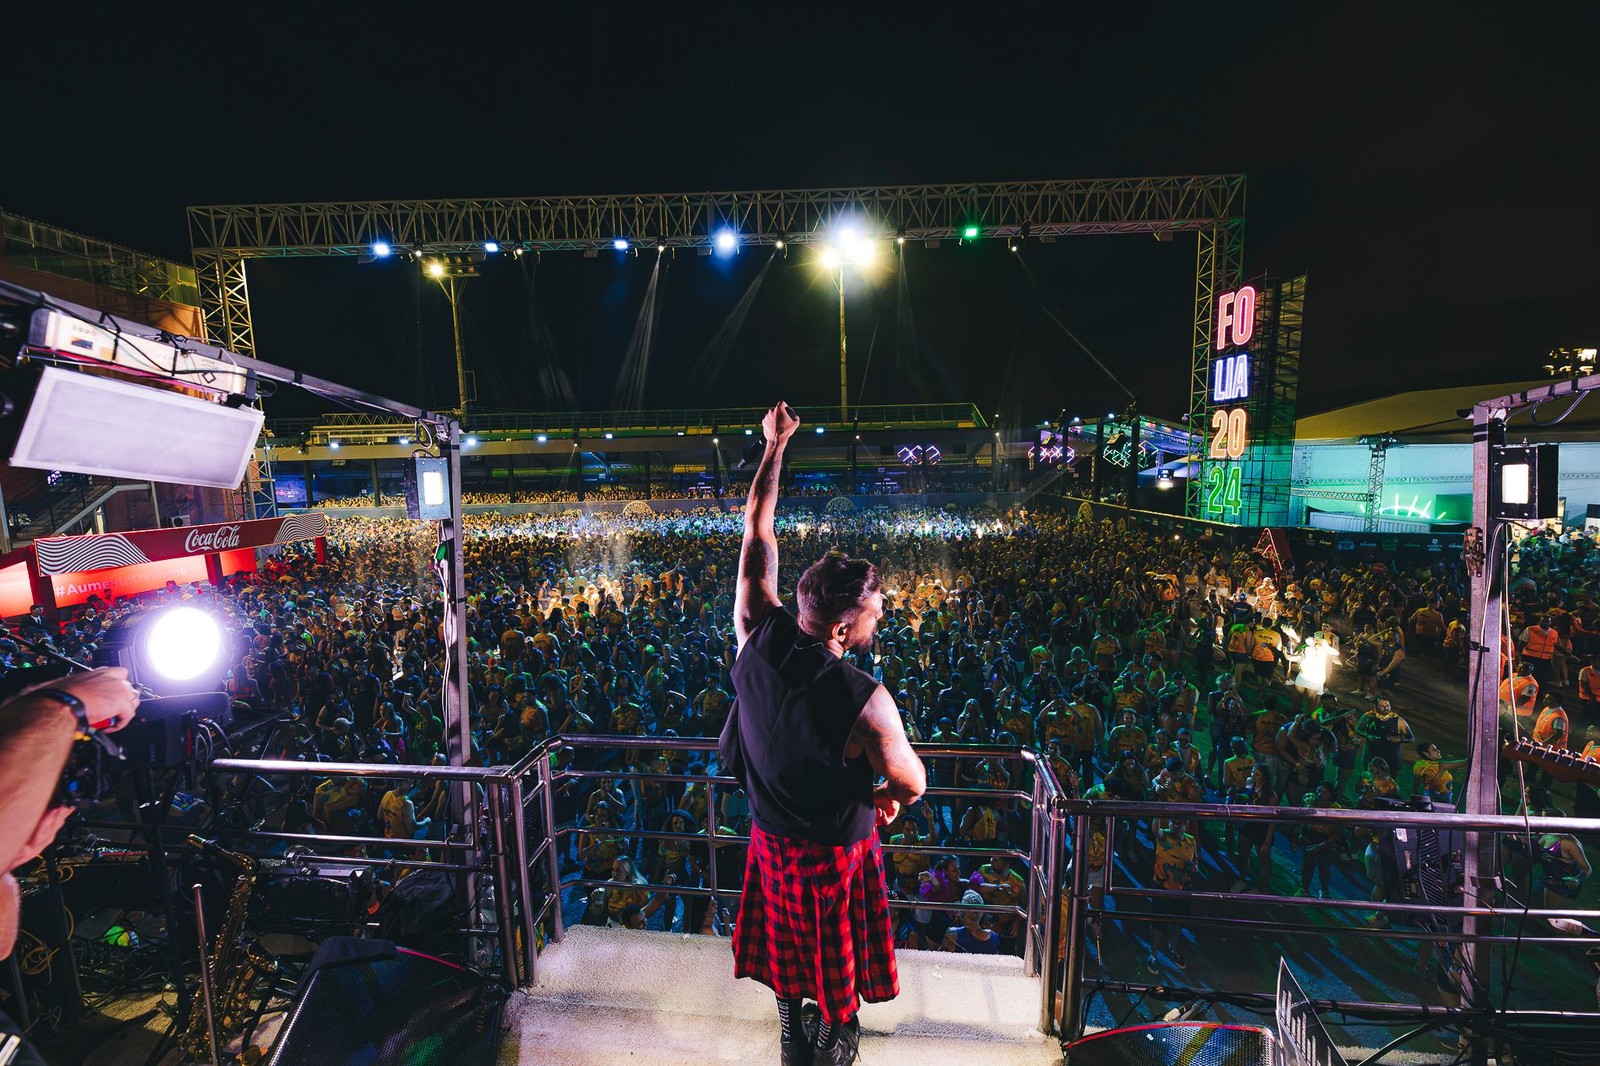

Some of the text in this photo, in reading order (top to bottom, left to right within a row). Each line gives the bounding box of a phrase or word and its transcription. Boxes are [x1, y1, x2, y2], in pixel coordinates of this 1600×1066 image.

[1216, 286, 1256, 351] FO
[1213, 353, 1249, 401] LIA
[1210, 408, 1247, 460] 20
[1207, 466, 1242, 516] 24
[185, 525, 241, 553] Coca-Cola
